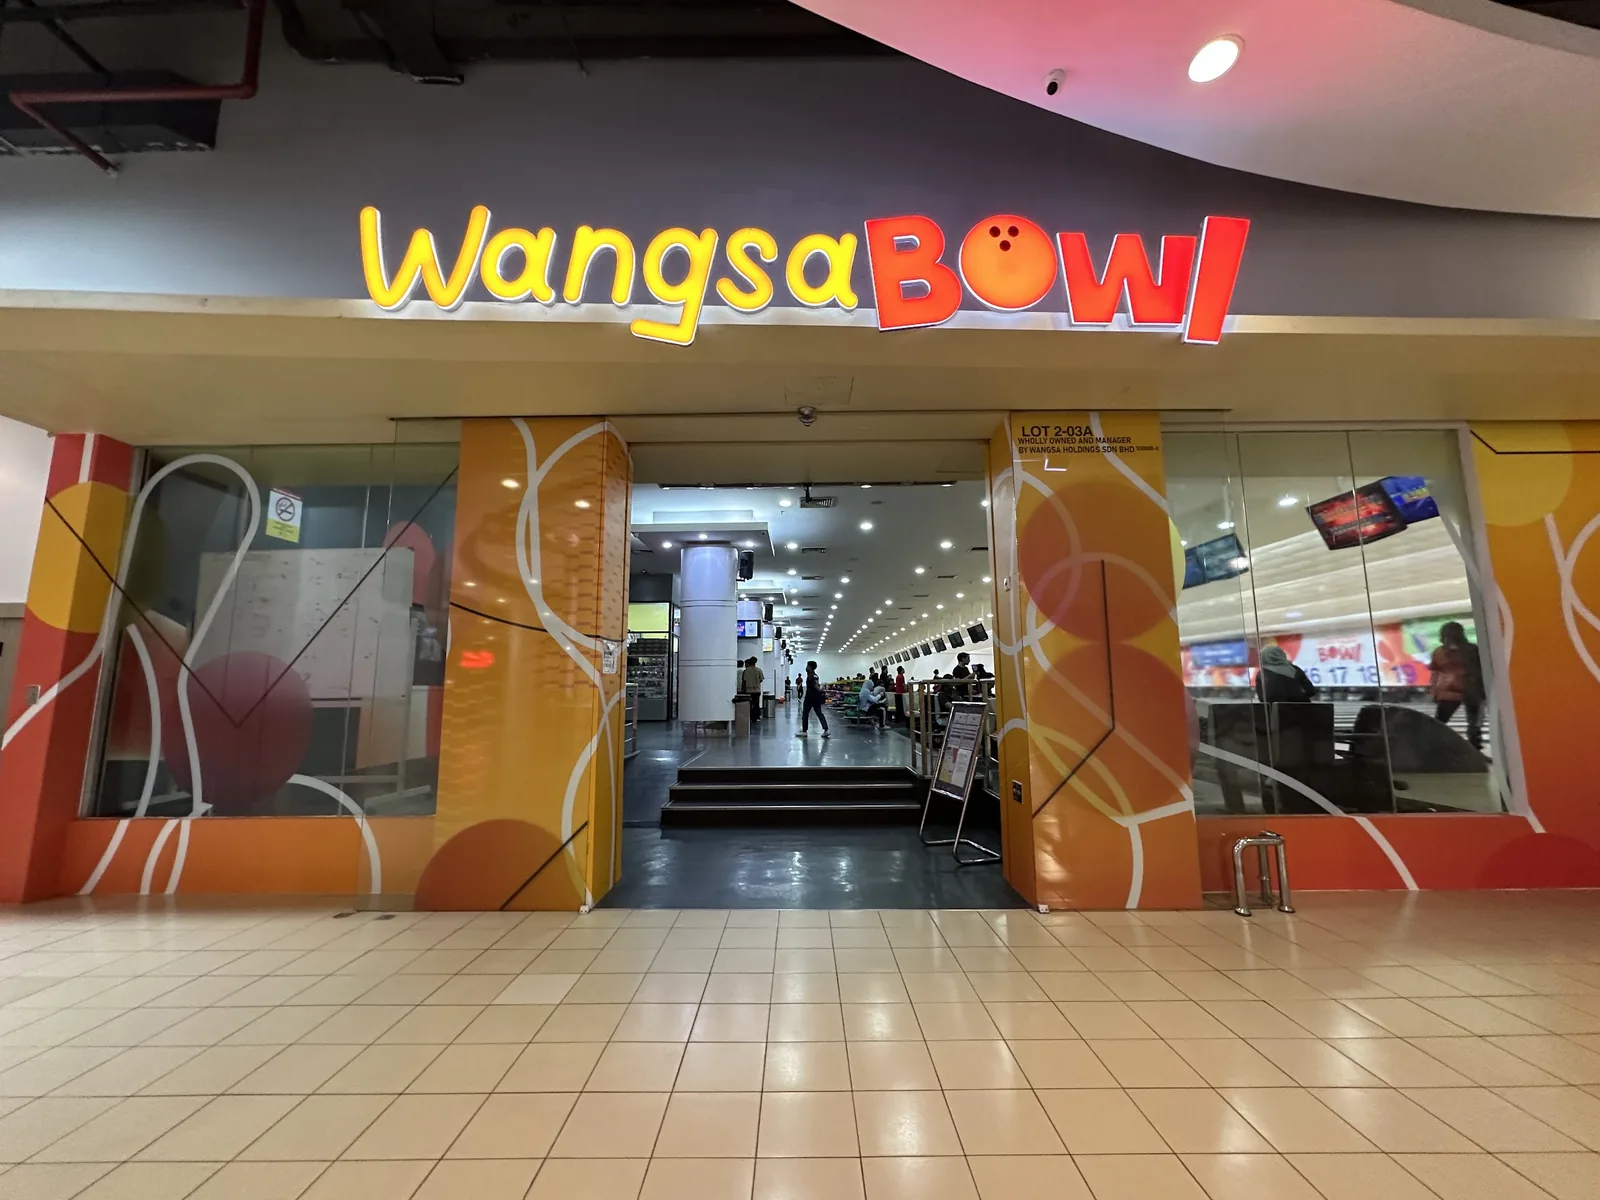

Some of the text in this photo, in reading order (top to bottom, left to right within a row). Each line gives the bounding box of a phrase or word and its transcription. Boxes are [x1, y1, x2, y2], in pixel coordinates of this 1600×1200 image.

[360, 205, 858, 345] Wangsa
[1021, 425, 1094, 437] LOT 2-03A
[1018, 437, 1048, 445] WHOLLY
[1049, 437, 1076, 445] OWNED
[1095, 436, 1132, 444] MANAGER
[1018, 446, 1028, 454] BY
[1029, 446, 1061, 454] WANGSA
[1119, 445, 1135, 453] BHD
[1328, 666, 1349, 684] 17
[1357, 665, 1379, 684] 18
[1390, 663, 1418, 684] 19
